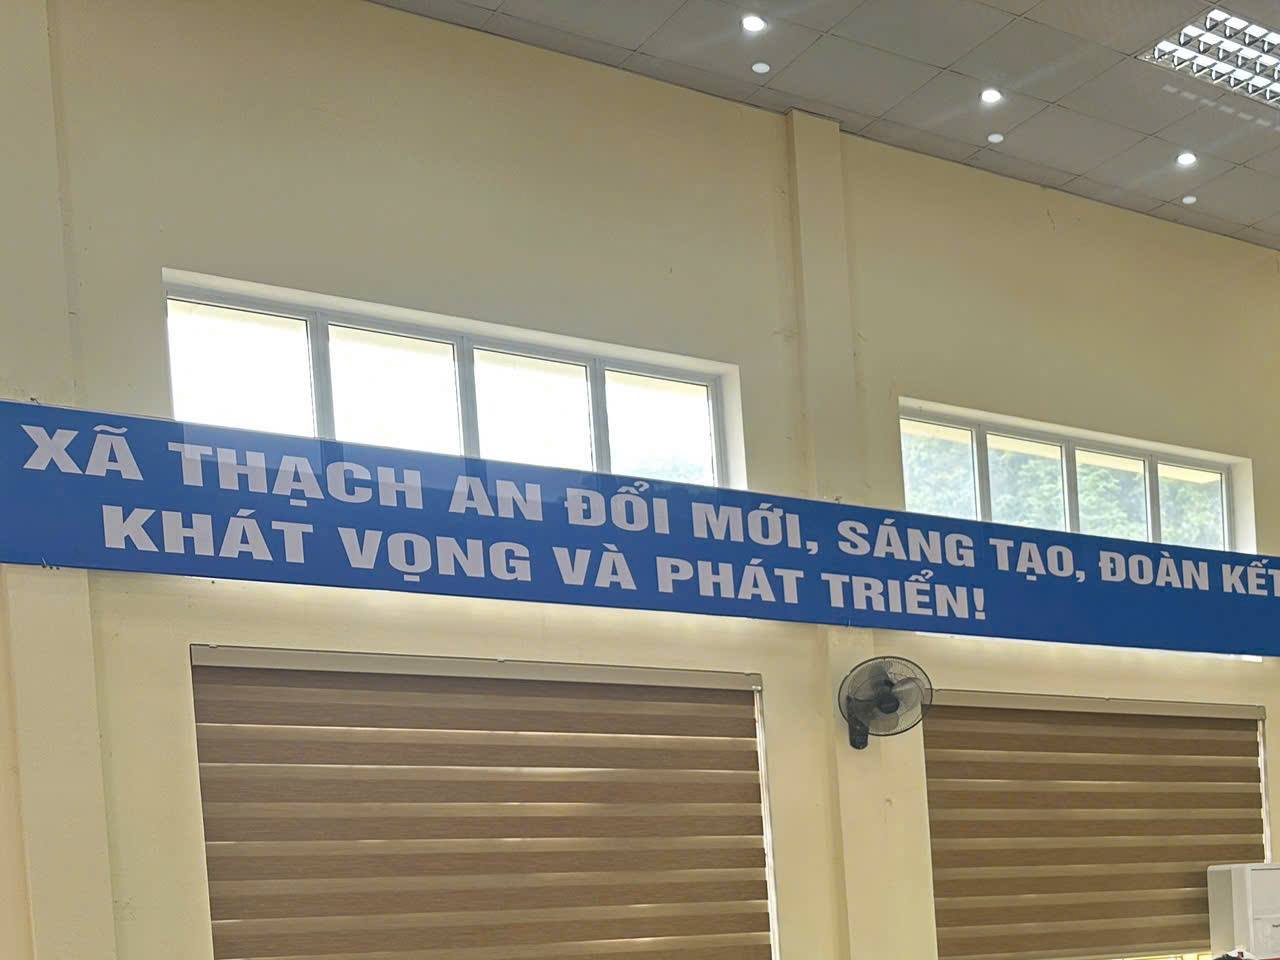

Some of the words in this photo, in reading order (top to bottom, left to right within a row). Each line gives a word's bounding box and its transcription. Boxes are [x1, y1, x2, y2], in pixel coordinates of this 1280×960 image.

[22, 424, 143, 480] XÃ
[168, 442, 422, 510] THẠCH
[449, 475, 542, 521] AN
[565, 481, 669, 535] ĐỔI
[692, 501, 818, 555] MỚI,
[838, 518, 976, 568] SÁNG
[990, 539, 1085, 583] TẠO,
[1099, 551, 1208, 590] ĐOÀN
[103, 505, 314, 563] KHÁT
[338, 525, 531, 582] VỌNG
[553, 543, 636, 589] VÀ
[657, 557, 803, 604] PHÁT
[821, 568, 985, 619] TRIỂN!
